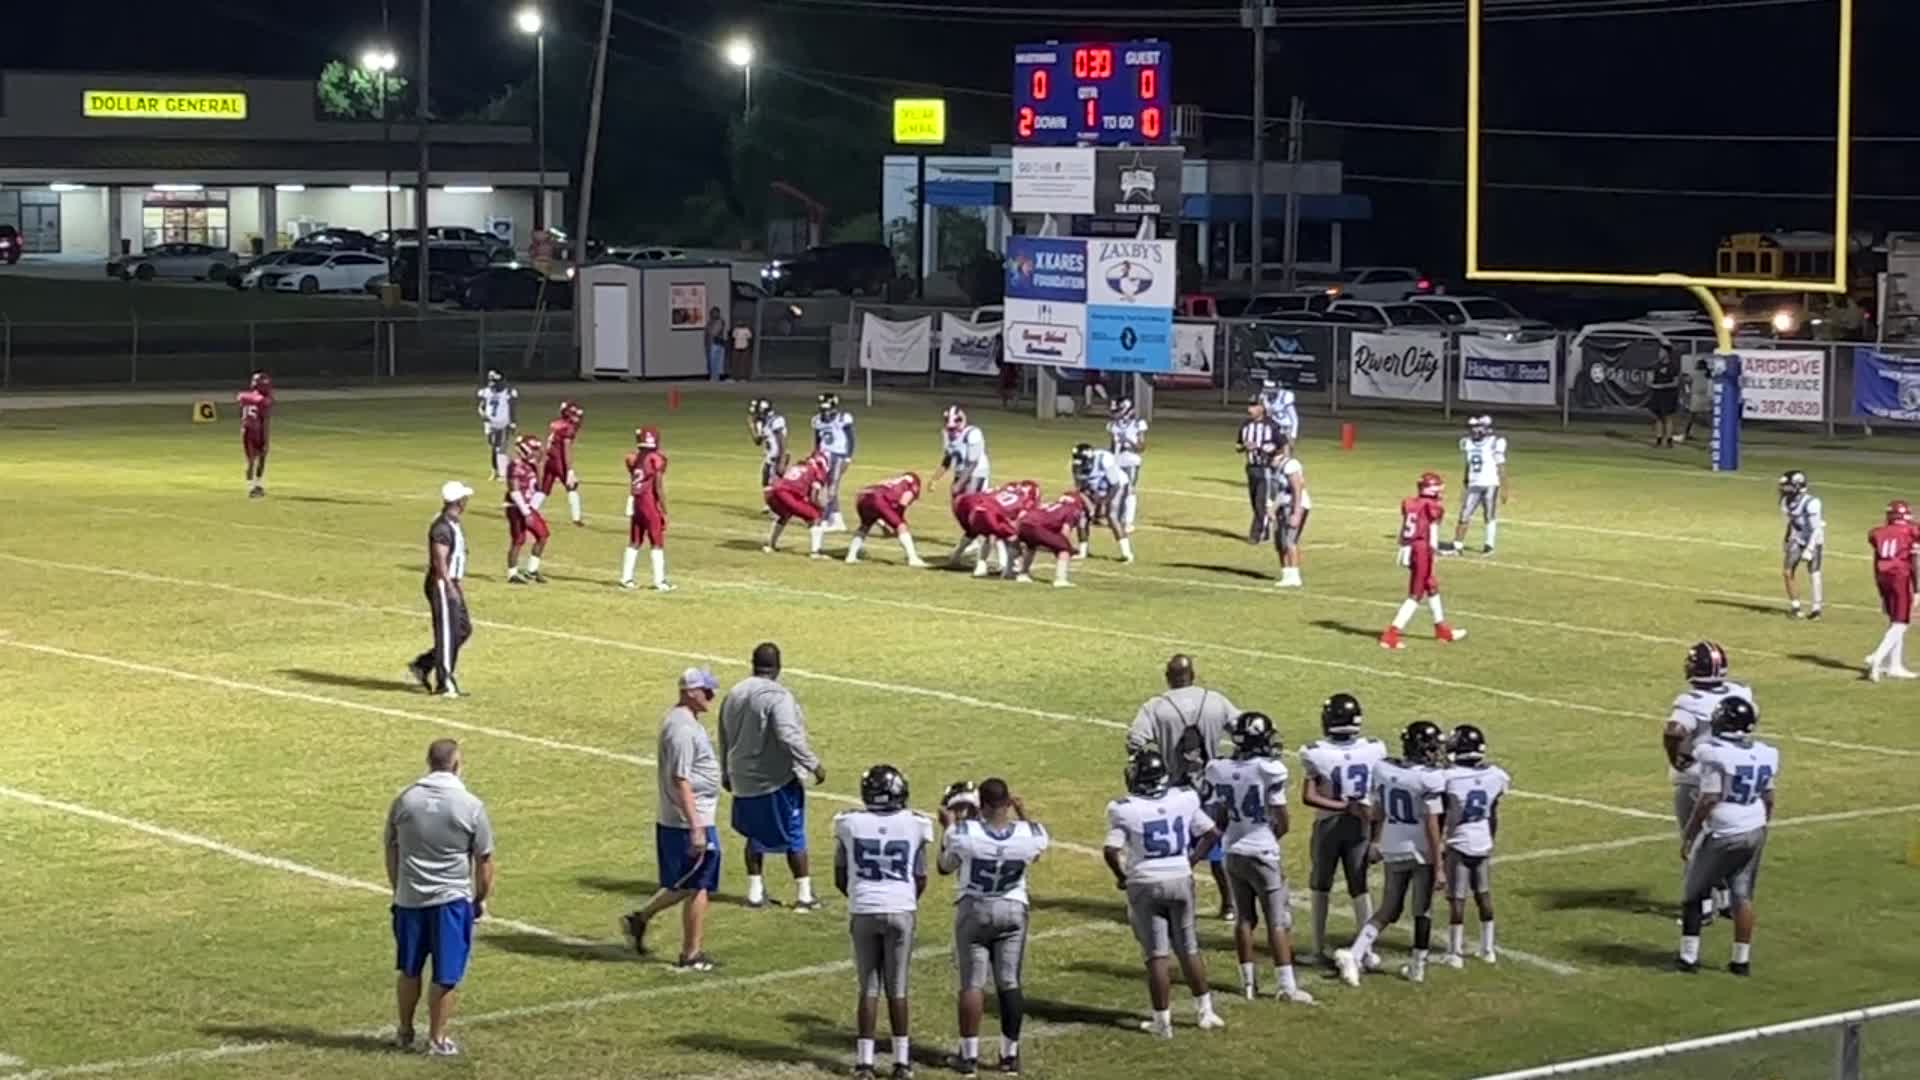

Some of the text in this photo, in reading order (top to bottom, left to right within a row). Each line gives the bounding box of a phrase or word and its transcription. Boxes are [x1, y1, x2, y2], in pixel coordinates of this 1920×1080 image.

[1125, 51, 1161, 65] GUEST
[1033, 70, 1047, 99] 0
[1141, 69, 1155, 99] 0
[91, 95, 240, 113] DOLLAR GENERAL
[1086, 99, 1096, 126] 1
[1018, 107, 1067, 137] 2 DOWN
[1102, 115, 1116, 129] TO
[1118, 115, 1134, 129] GO
[1099, 242, 1163, 265] ZAXBY'S
[1353, 344, 1440, 383] River City
[1743, 358, 1821, 375] ARGROVE
[1741, 376, 1821, 392] ELL SERVICE
[200, 403, 214, 419] G
[489, 401, 499, 417] 7
[1760, 399, 1820, 417] 387-0520
[1881, 539, 1897, 559] 11
[1331, 763, 1369, 800] 13
[1143, 816, 1185, 859] 51
[852, 837, 911, 884] 53
[966, 858, 1026, 897] 52
